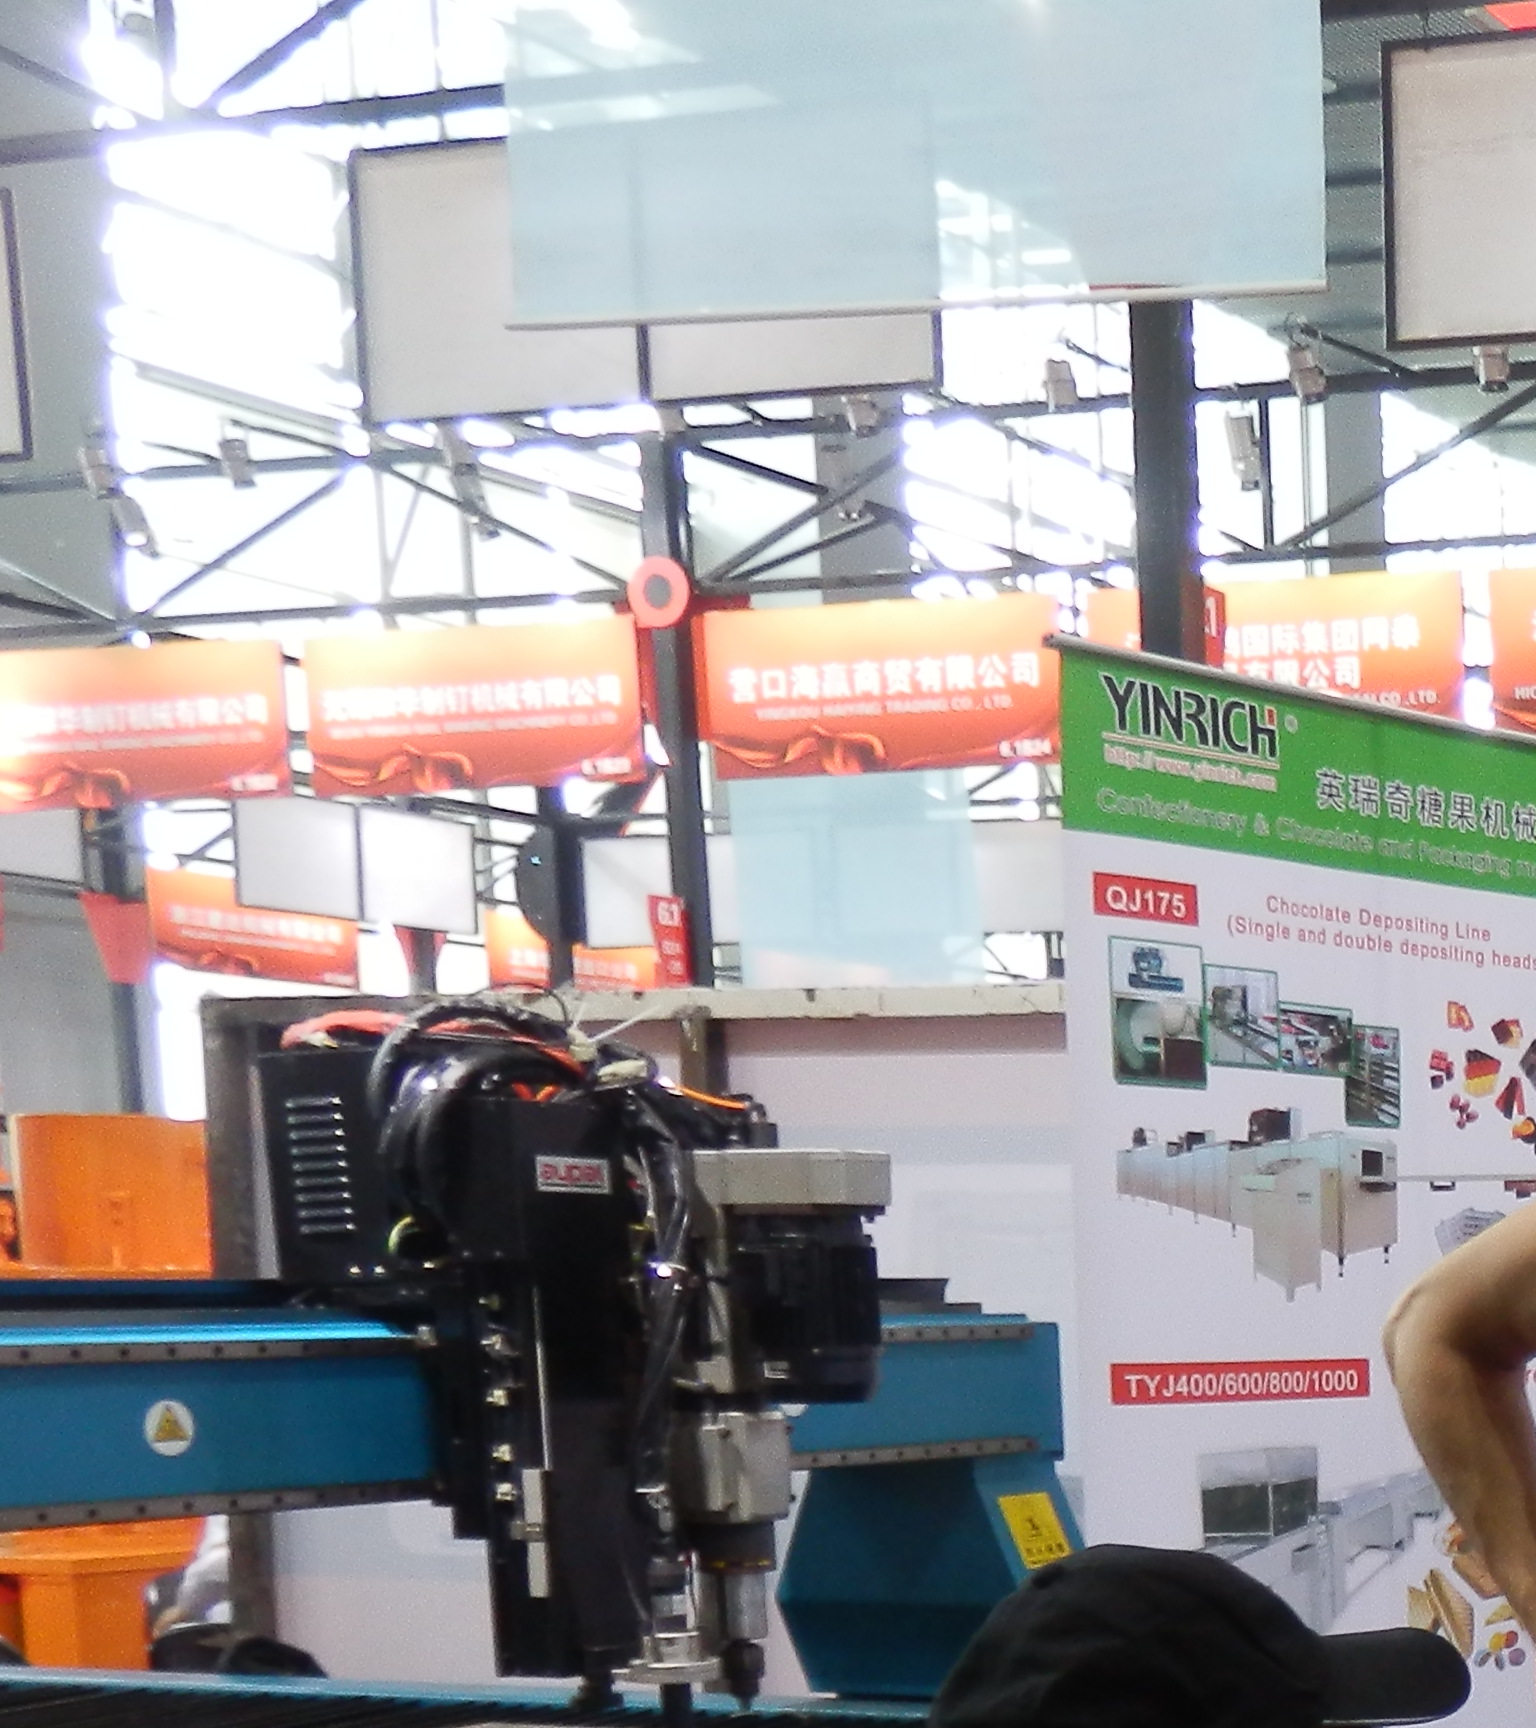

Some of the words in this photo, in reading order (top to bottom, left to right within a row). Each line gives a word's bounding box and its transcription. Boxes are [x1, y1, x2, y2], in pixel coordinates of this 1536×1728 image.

[1100, 671, 1279, 760] YINRICH
[1105, 885, 1187, 919] QJ175
[1266, 895, 1351, 924] Chocolate
[1359, 908, 1449, 941] Depositing
[1455, 920, 1492, 942] Line
[1226, 913, 1291, 942] (Single
[1299, 926, 1326, 945] and
[1334, 930, 1392, 953] double
[1400, 939, 1485, 968] depositing
[1125, 1369, 1359, 1399] TYJ400/600/800/1000
